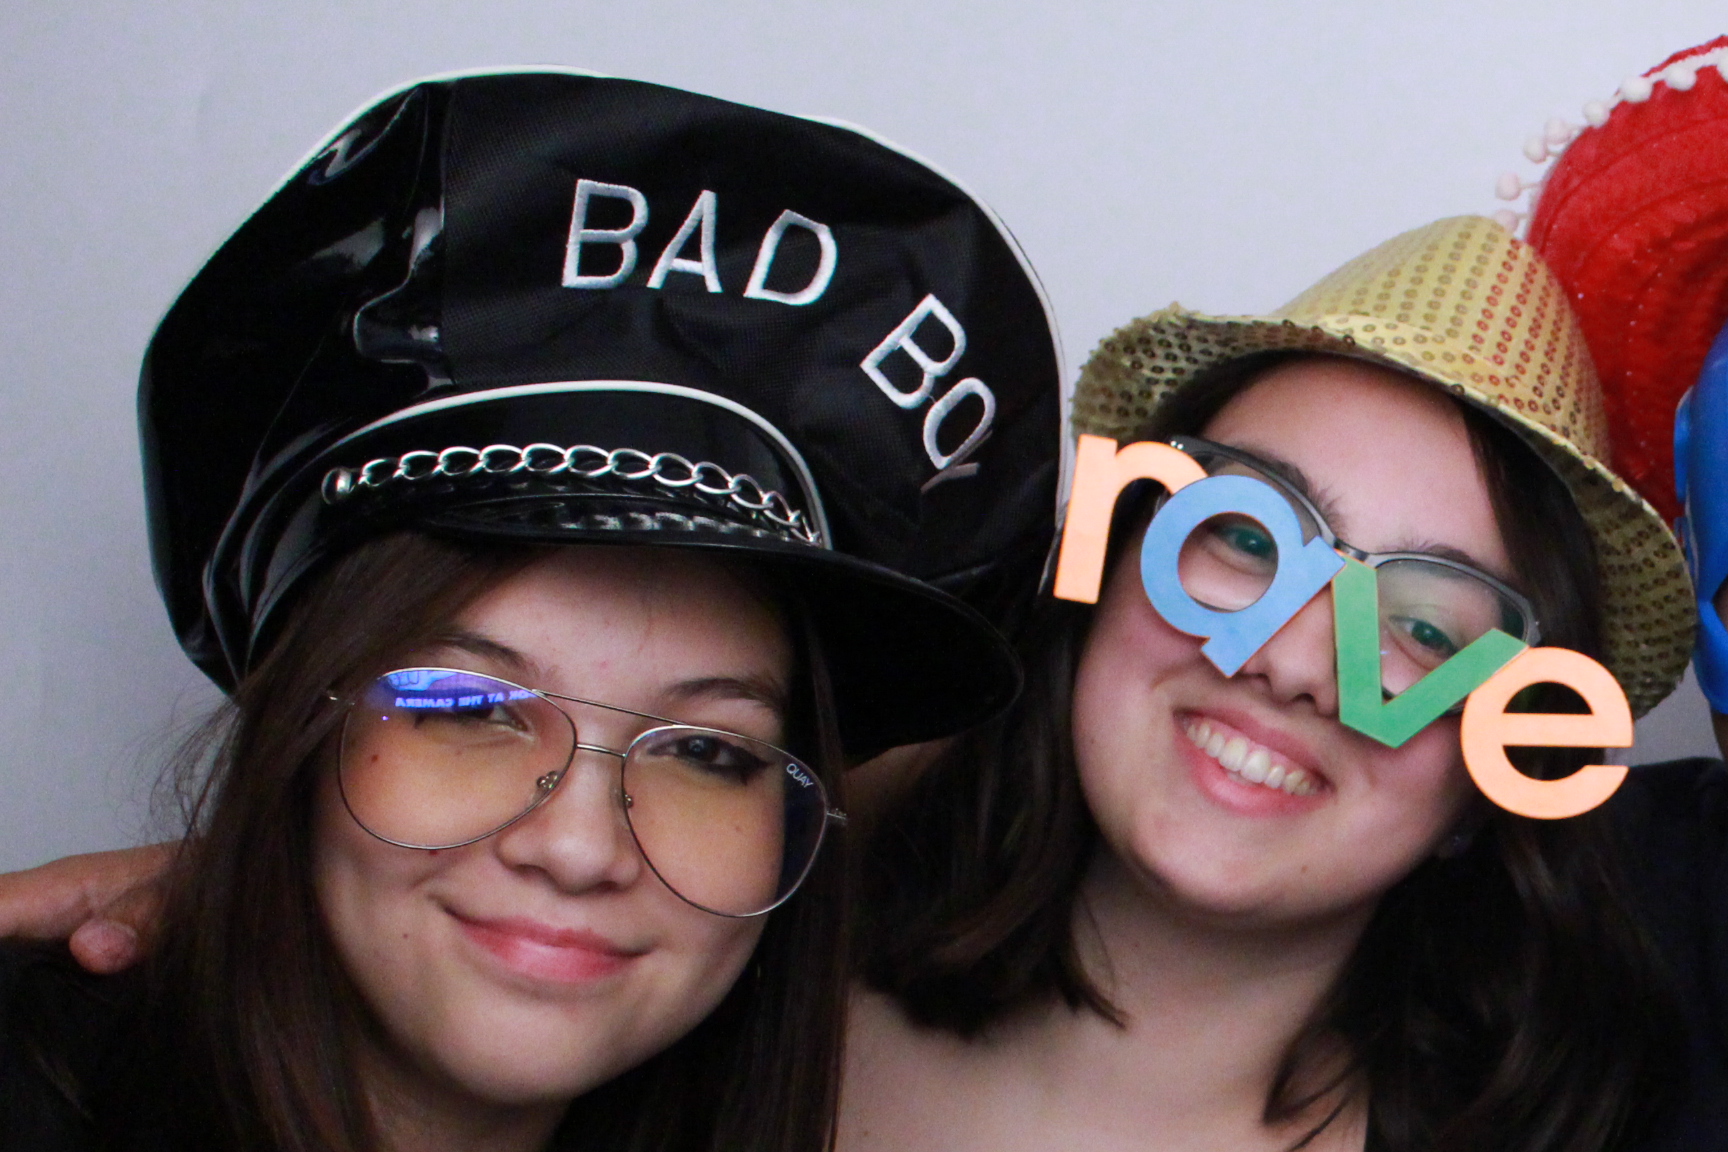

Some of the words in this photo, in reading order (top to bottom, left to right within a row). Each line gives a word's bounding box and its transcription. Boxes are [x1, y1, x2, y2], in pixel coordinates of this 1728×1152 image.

[561, 177, 838, 306] BAD
[1053, 433, 1634, 820] rave
[786, 763, 814, 788] QUAY
